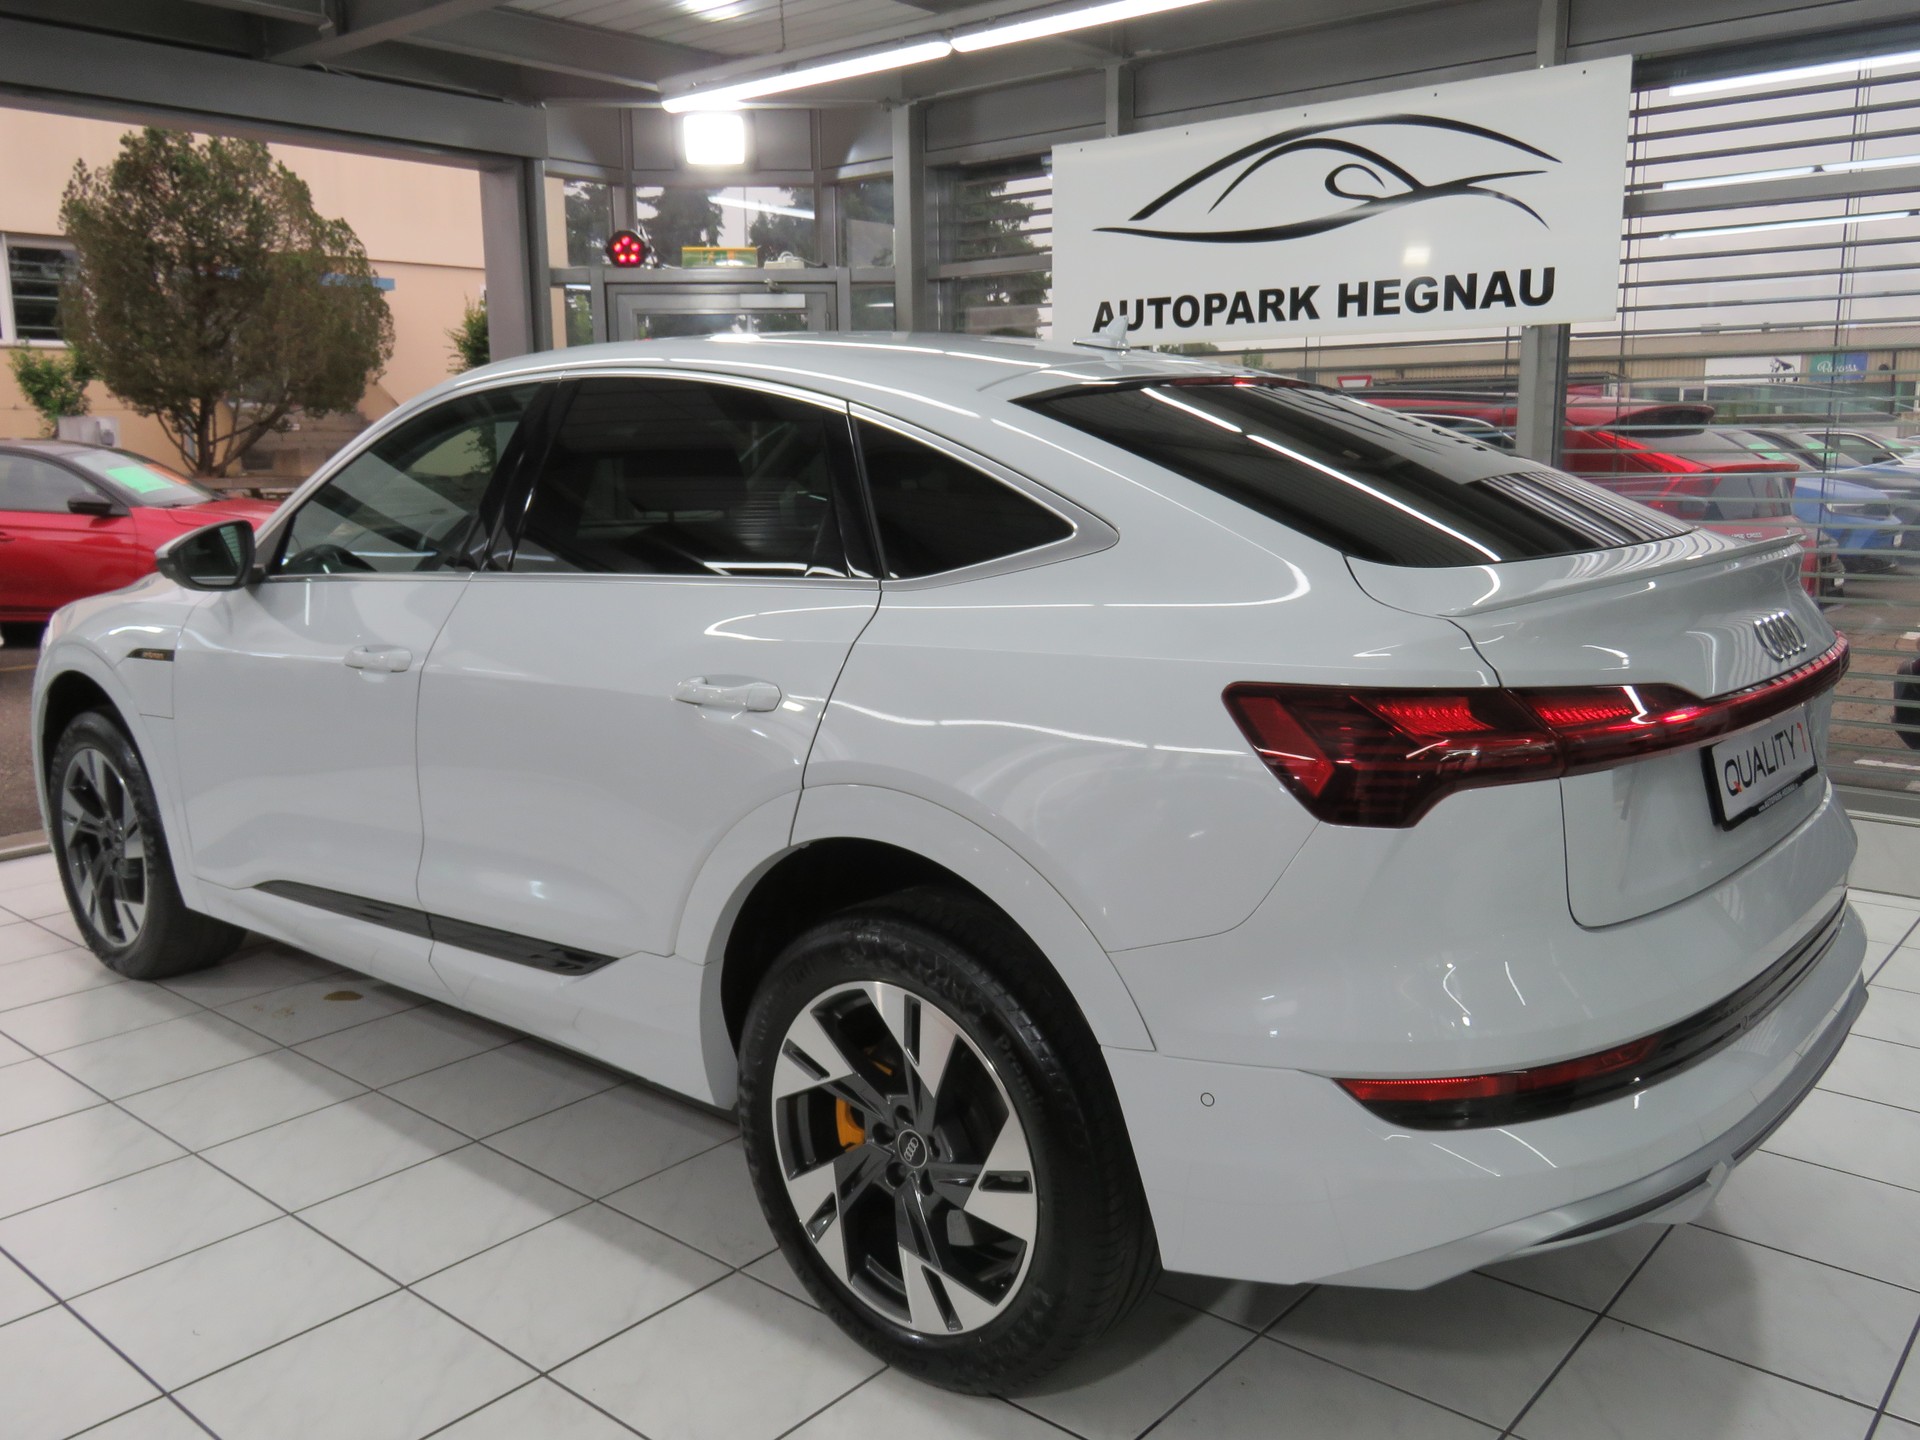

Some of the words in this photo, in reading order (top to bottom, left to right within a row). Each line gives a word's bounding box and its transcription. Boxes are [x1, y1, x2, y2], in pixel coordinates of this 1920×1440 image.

[1092, 285, 1320, 334] AUTOPARK
[1337, 267, 1555, 319] HEGNAU
[1724, 725, 1796, 797] QUALITY
[1796, 722, 1807, 753] 1
